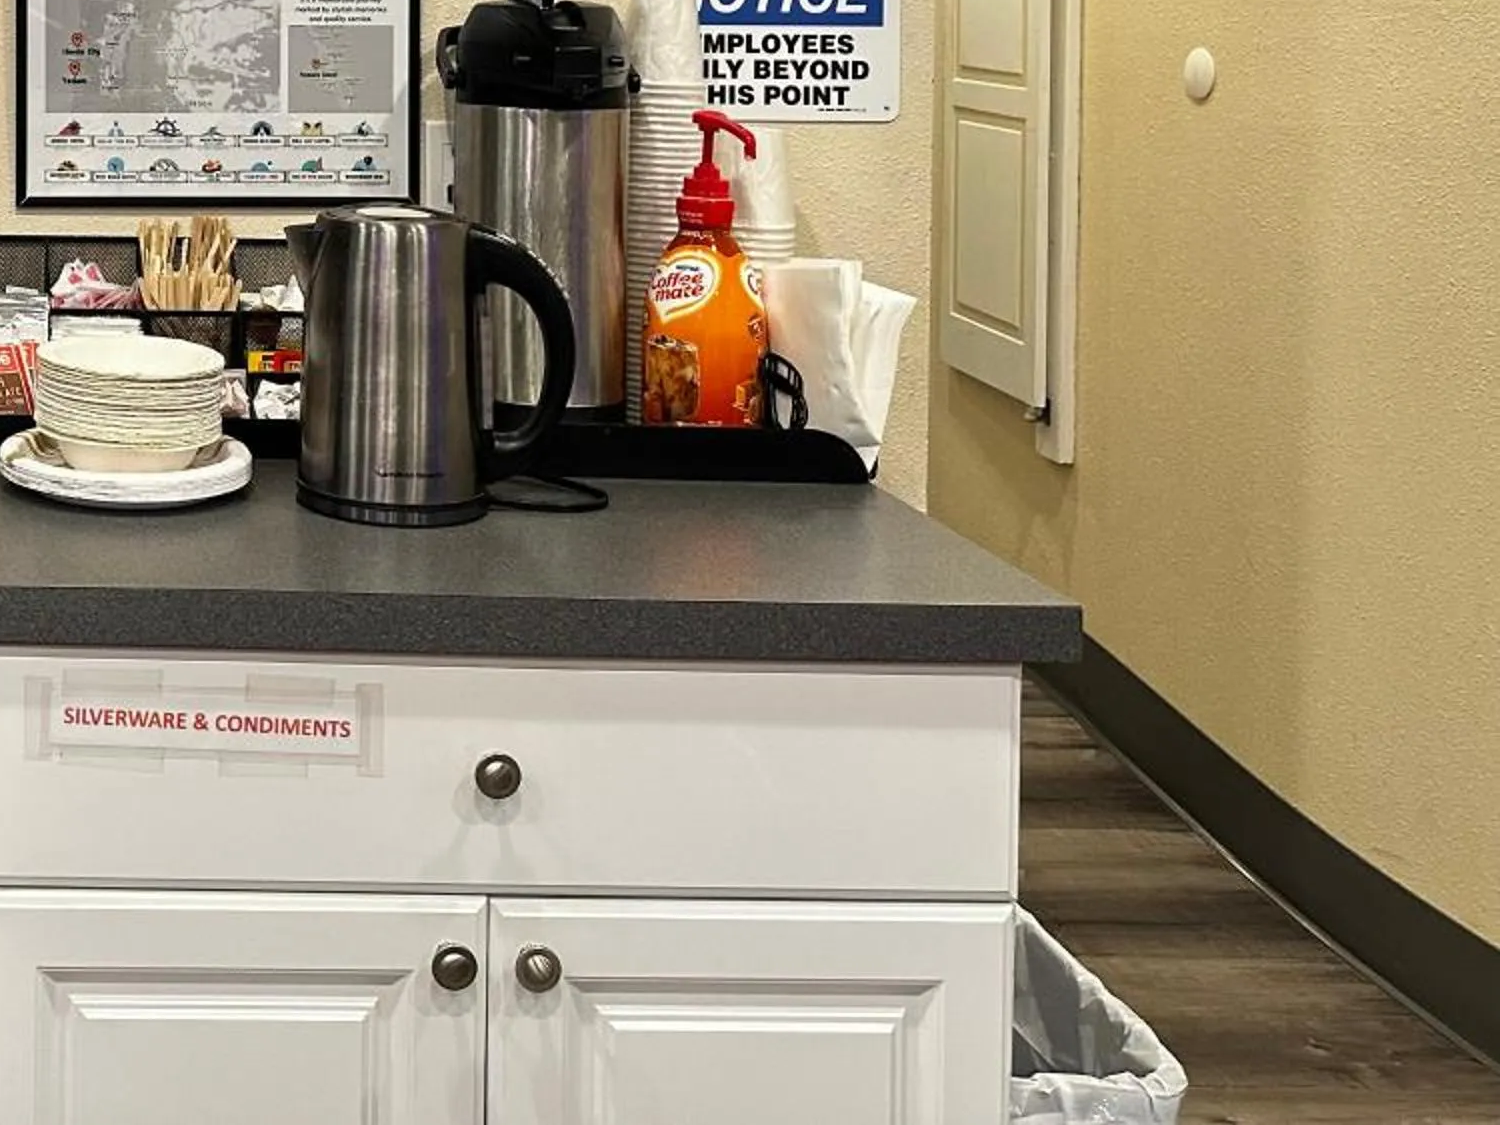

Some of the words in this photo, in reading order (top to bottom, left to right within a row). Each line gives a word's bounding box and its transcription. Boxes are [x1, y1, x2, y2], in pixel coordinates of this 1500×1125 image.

[702, 34, 855, 54] MPLOYEES
[703, 59, 745, 80] LY
[753, 60, 870, 81] BEYOND
[707, 85, 755, 105] HIS
[763, 86, 850, 106] POINT
[63, 707, 188, 731] SILVERWARE
[193, 712, 209, 732] &
[215, 713, 352, 739] CONDIMENTS
